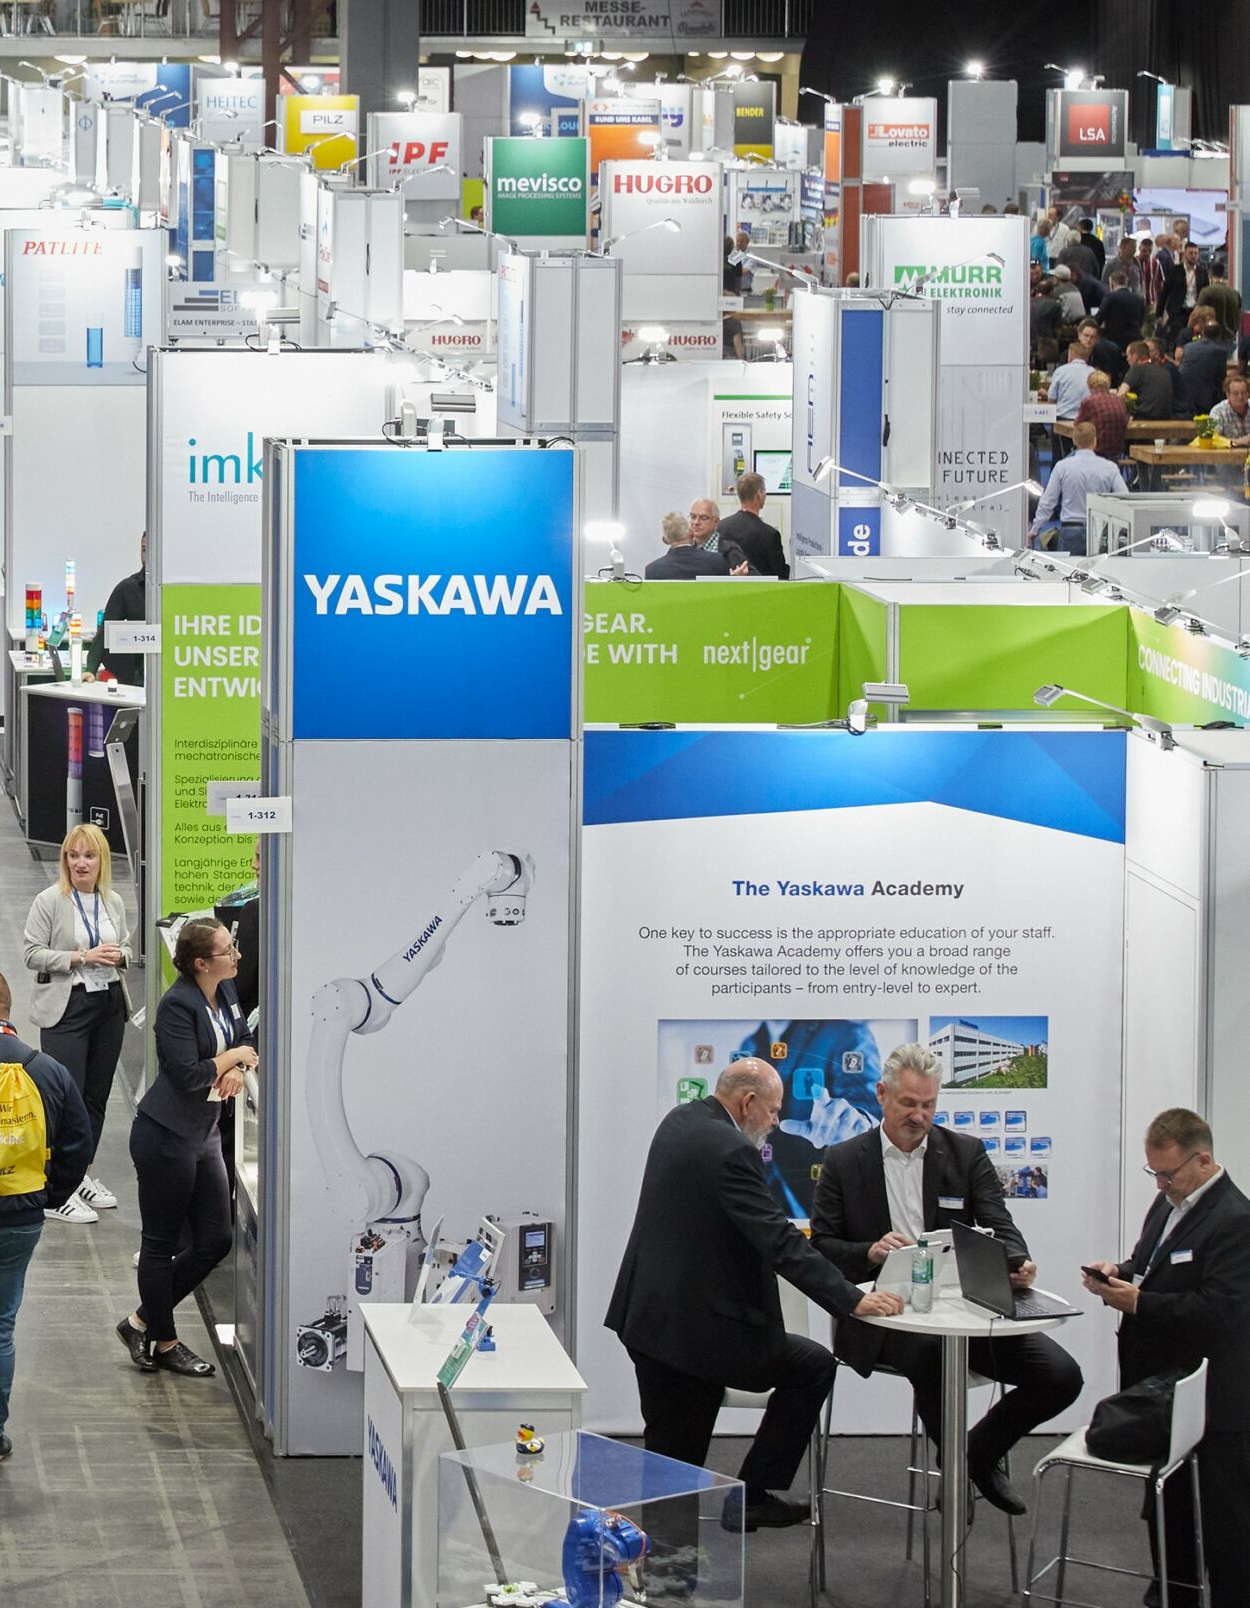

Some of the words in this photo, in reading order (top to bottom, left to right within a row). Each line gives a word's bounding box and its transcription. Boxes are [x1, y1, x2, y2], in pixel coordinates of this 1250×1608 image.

[585, 0, 646, 13] MESSE-
[560, 15, 670, 27] RESTAURANT
[207, 96, 258, 108] HEITEC
[736, 107, 764, 117] BENDER
[313, 115, 344, 125] PILZ
[1079, 128, 1105, 141] LSA
[889, 140, 928, 148] electric
[389, 142, 448, 165] IPF
[497, 173, 582, 192] mevisco
[614, 175, 713, 193] HUGRO
[22, 241, 104, 255] PATLITE
[930, 266, 1002, 284] MURR
[930, 288, 1002, 298] ELEKTRONIK
[946, 305, 965, 319] stay
[967, 304, 1013, 315] connected
[431, 335, 481, 345] HUGRO
[667, 335, 716, 345] HUGRO
[721, 410, 753, 419] Flexible
[756, 410, 782, 421] Safety
[189, 432, 263, 484] imk
[942, 470, 1009, 484] FUTURE
[189, 492, 205, 503] The
[207, 491, 259, 504] Intelligence
[304, 575, 563, 615] YASKAWA
[174, 615, 231, 635] IHRE
[174, 646, 259, 667] UNSER
[608, 644, 678, 664] WITH
[1138, 644, 1200, 697] CONNECTING
[174, 677, 262, 698] ENTWI
[174, 739, 258, 750] Interdisziplinäre
[174, 786, 196, 797] und
[248, 811, 276, 819] 1-312
[174, 822, 200, 832] Alles
[201, 824, 222, 832] aus
[174, 834, 233, 846] Konzeption
[236, 834, 253, 844] bis
[174, 857, 238, 870] Langjährige
[174, 869, 209, 879] hohen
[174, 882, 215, 893] technik,
[217, 882, 236, 892] der
[732, 880, 770, 896] The
[776, 880, 865, 896] Yaskawa
[870, 880, 965, 899] Academy
[174, 894, 205, 904] sowie
[402, 915, 443, 963] YASKAWA
[638, 926, 667, 939] One
[671, 926, 695, 943] key
[699, 926, 712, 939] to
[716, 929, 773, 939] success
[776, 926, 788, 939] is
[791, 926, 813, 939] the
[817, 926, 895, 943] appropriate
[899, 926, 967, 939] education
[970, 926, 984, 939] of
[988, 929, 1018, 943] your
[1022, 926, 1055, 939] staff.
[683, 944, 709, 957] The
[713, 944, 773, 957] Yaskawa
[776, 944, 841, 961] Academy
[845, 944, 884, 957] offers
[887, 947, 913, 961] you
[916, 947, 925, 957] a
[929, 944, 969, 957] broad
[972, 947, 1011, 961] range
[676, 963, 690, 976] of
[693, 966, 747, 976] courses
[751, 963, 802, 976] tailored
[806, 963, 820, 976] to
[822, 963, 845, 976] the
[849, 963, 879, 976] level
[883, 963, 897, 976] of
[901, 963, 975, 979] knowledge
[979, 963, 992, 976] of
[996, 963, 1018, 976] the
[711, 981, 792, 998] participants
[807, 981, 839, 994] from
[843, 981, 914, 998] entry-level
[917, 981, 931, 994] to
[934, 981, 982, 998] expert.
[367, 1413, 398, 1515] YASKAWA
